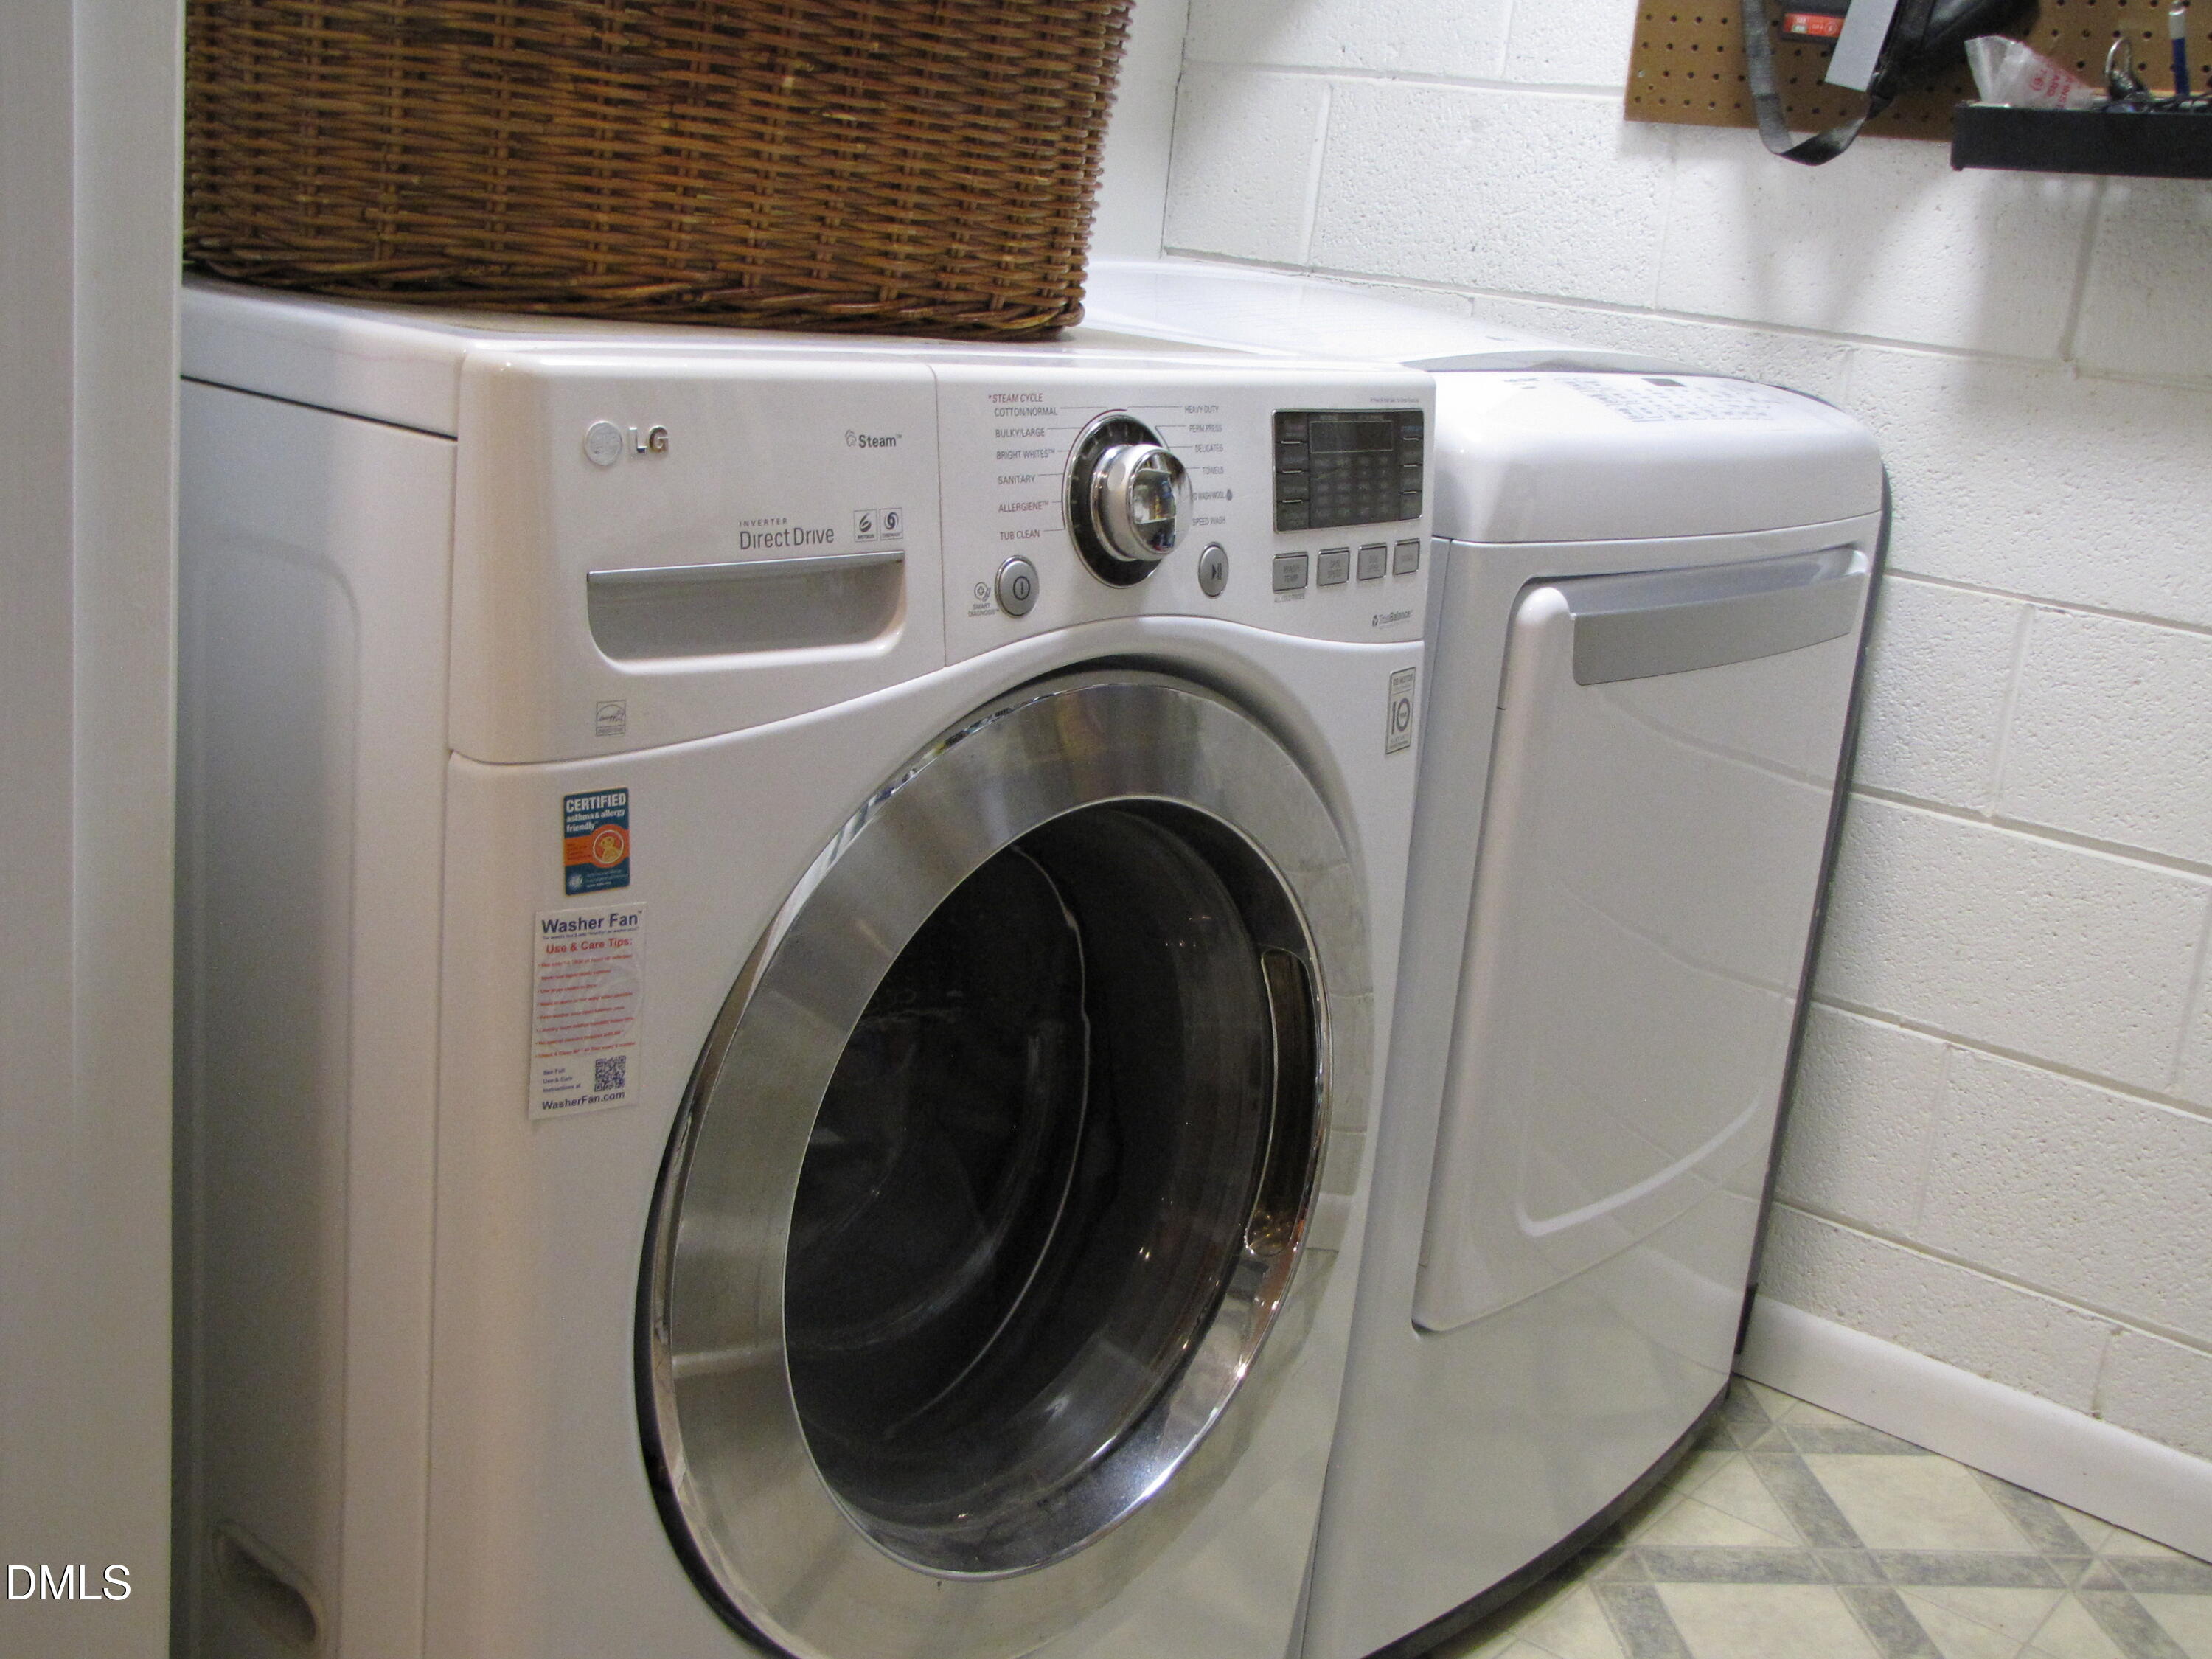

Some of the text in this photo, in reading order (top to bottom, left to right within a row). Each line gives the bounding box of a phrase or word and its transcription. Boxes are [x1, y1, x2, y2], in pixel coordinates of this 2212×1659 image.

[1020, 393, 1043, 403] CYCLE
[994, 406, 1058, 417] COTTON/NORMAL
[1203, 405, 1219, 414] DUTY
[995, 428, 1046, 438] BULKY/LARGE
[629, 425, 669, 455] LG
[1194, 443, 1224, 453] DELICATES
[996, 450, 1021, 460] BRIGHT
[1203, 466, 1224, 475] TOWELS
[998, 474, 1036, 484] SANITARY
[739, 518, 787, 527] INVERTER
[1192, 516, 1225, 526] SPEED WASH
[740, 527, 835, 550] Direct Drive
[1000, 529, 1040, 540] TUB CLEAN
[566, 792, 627, 813] CERTIFIED
[566, 813, 594, 823] asthma
[601, 808, 625, 819] allergy
[566, 821, 595, 832] friendly
[542, 917, 604, 934] Washer
[546, 937, 633, 954] Use & Care Tips:
[542, 1091, 625, 1110] WasherFan.com
